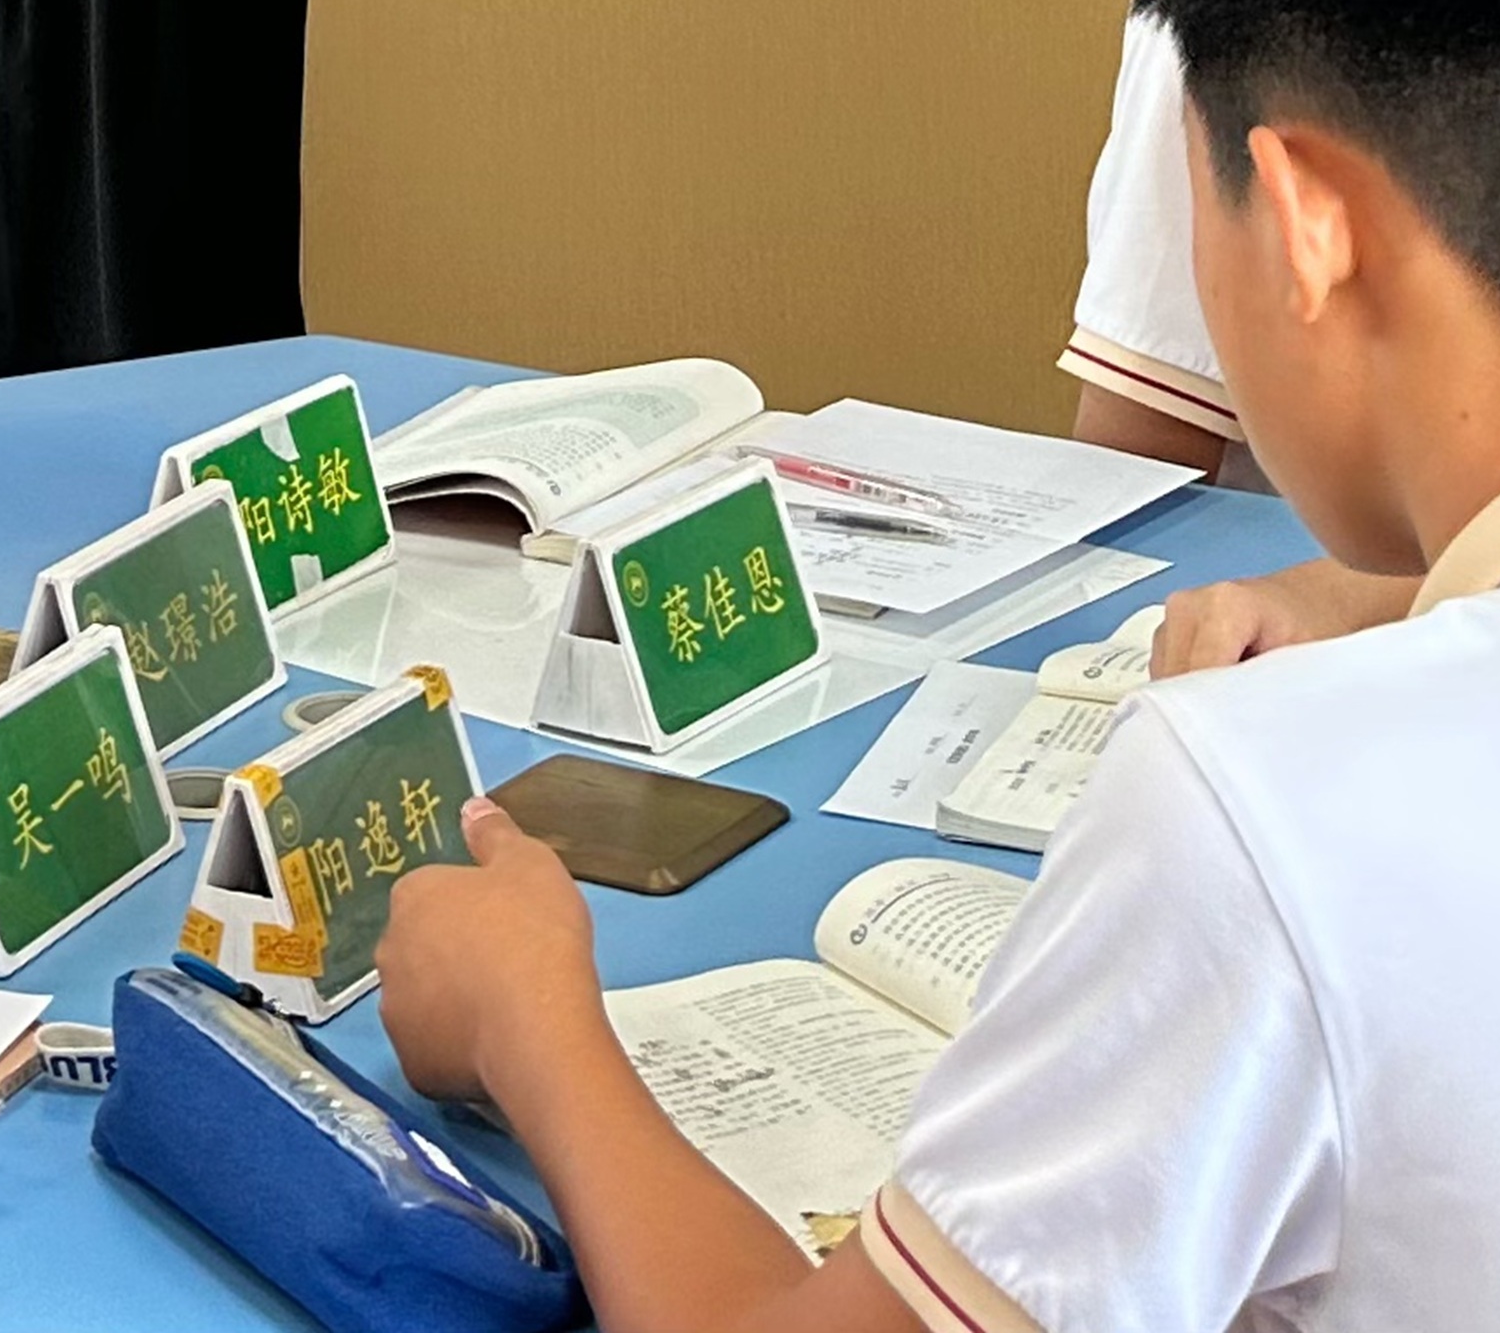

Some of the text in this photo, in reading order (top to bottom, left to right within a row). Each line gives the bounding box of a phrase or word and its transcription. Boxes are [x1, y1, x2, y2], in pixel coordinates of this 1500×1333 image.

[238, 447, 362, 545] 阳诗敏
[661, 546, 785, 663] 蔡佳恩
[7, 727, 132, 871] 吴一鸣
